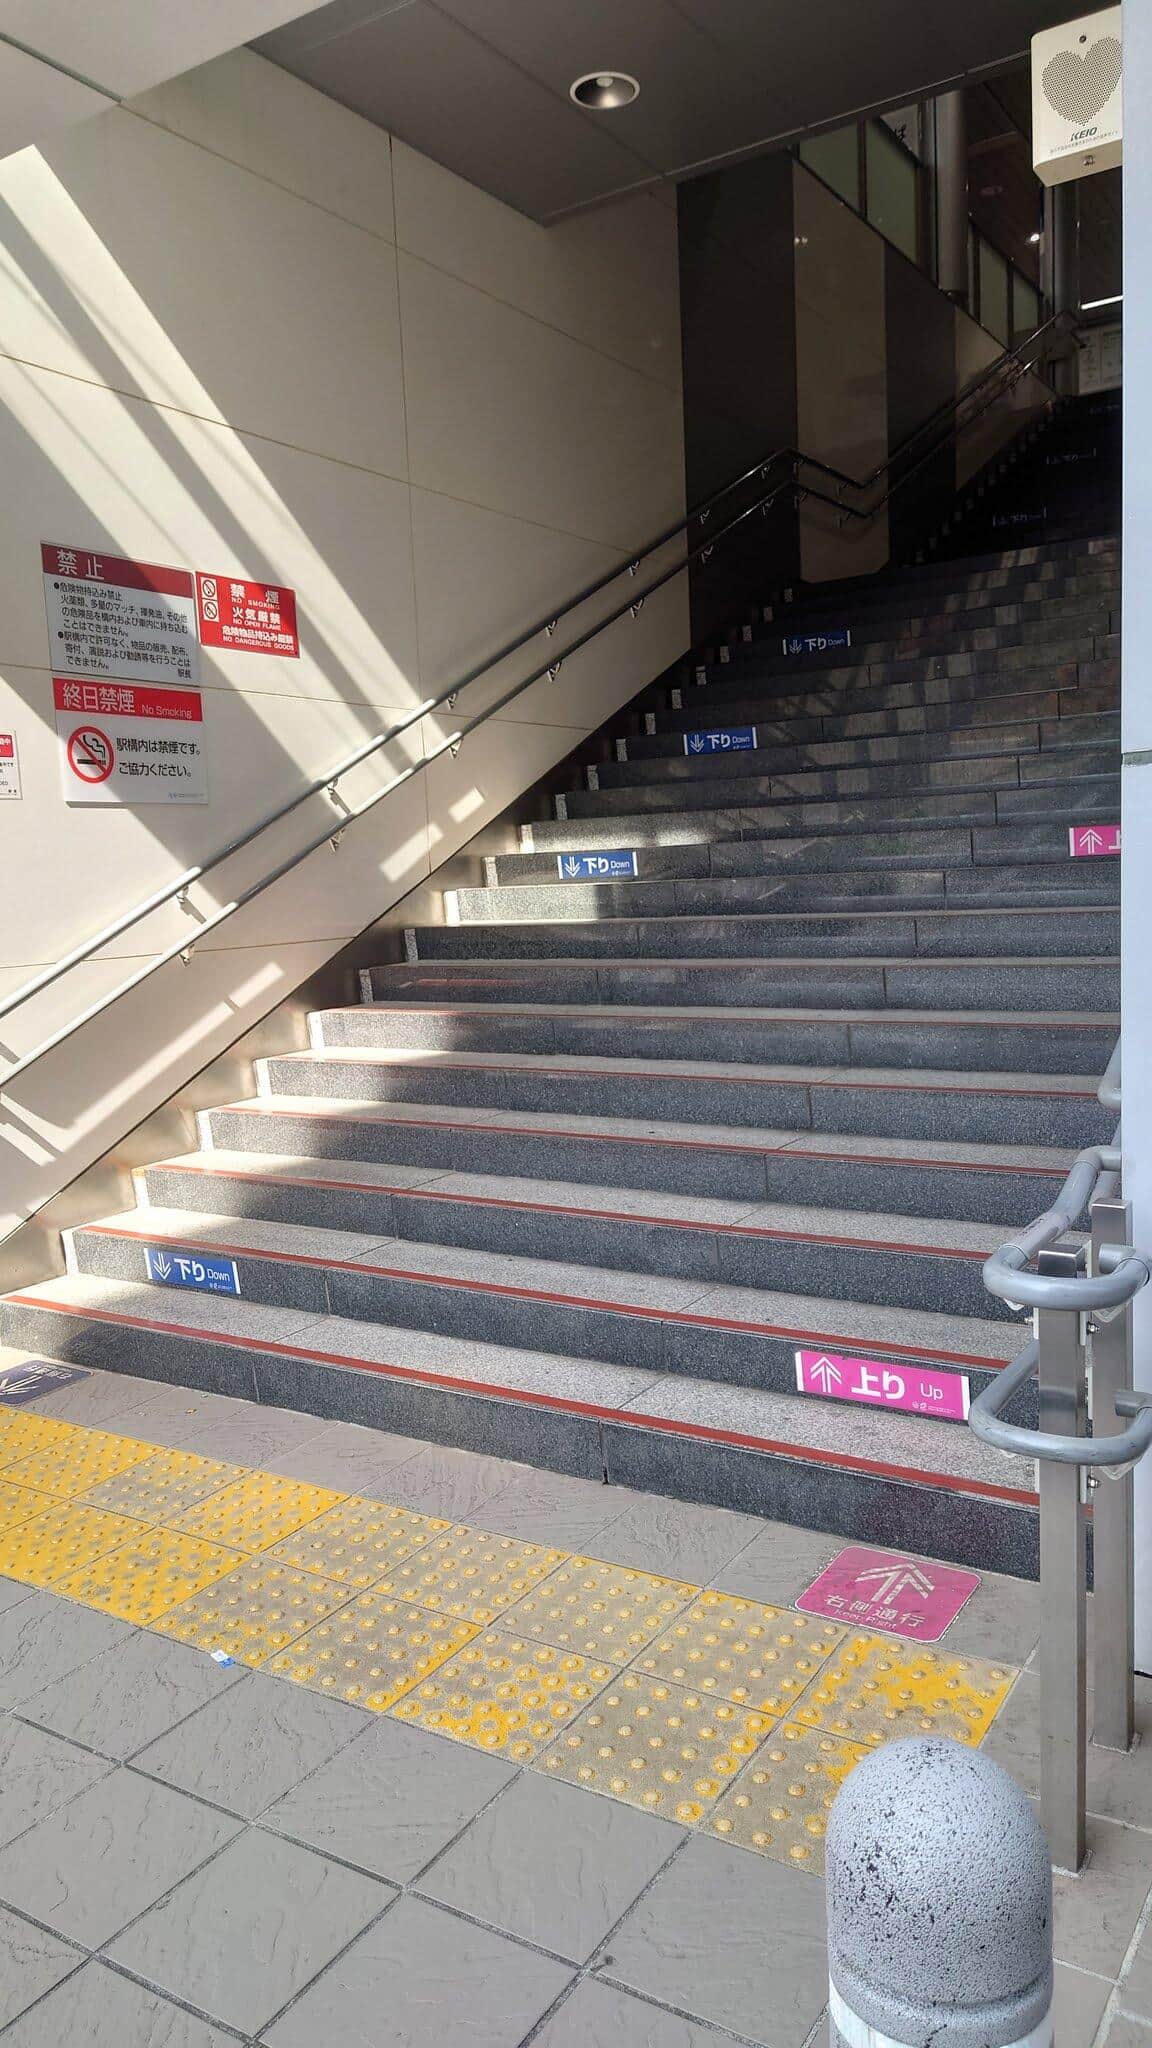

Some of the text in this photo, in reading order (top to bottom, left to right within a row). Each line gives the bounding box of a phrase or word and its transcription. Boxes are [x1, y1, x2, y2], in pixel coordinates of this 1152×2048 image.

[1070, 127, 1098, 141] KEIO
[57, 549, 104, 580] 禁止
[248, 600, 280, 609] SMOKING
[233, 607, 280, 624] 火気厳禁
[235, 637, 272, 648] DANGEROUS
[274, 643, 294, 651] GOODS
[805, 637, 827, 651] 下り
[63, 683, 135, 713] 終日禁煙
[141, 704, 192, 719] No Smoking
[116, 737, 200, 755] 駅構内は禁煙です。
[707, 734, 730, 749] 下り
[732, 736, 750, 744] Down
[119, 762, 192, 777] ご協力ください。
[582, 857, 609, 874] 下り
[611, 861, 630, 869] Down
[174, 1258, 230, 1281] 下り Down
[851, 1366, 943, 1400] 上り Up
[824, 1595, 926, 1627] 右側通行
